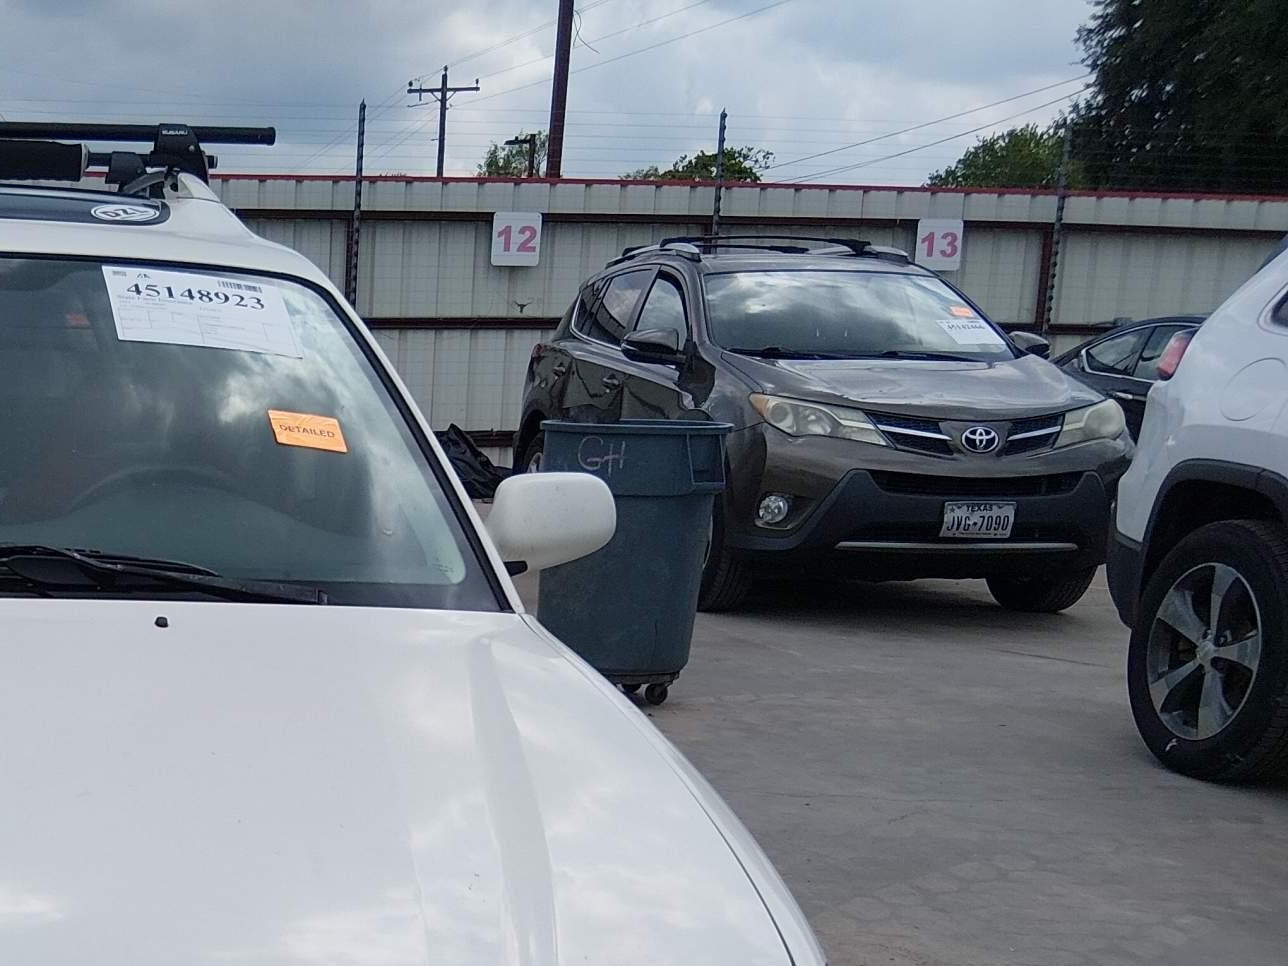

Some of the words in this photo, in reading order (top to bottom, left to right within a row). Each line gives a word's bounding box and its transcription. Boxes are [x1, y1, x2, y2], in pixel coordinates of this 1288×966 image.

[497, 225, 537, 252] 12
[921, 231, 958, 257] 13
[126, 282, 265, 310] 45148923
[279, 424, 336, 438] DETAILED
[966, 504, 993, 512] TEXAS
